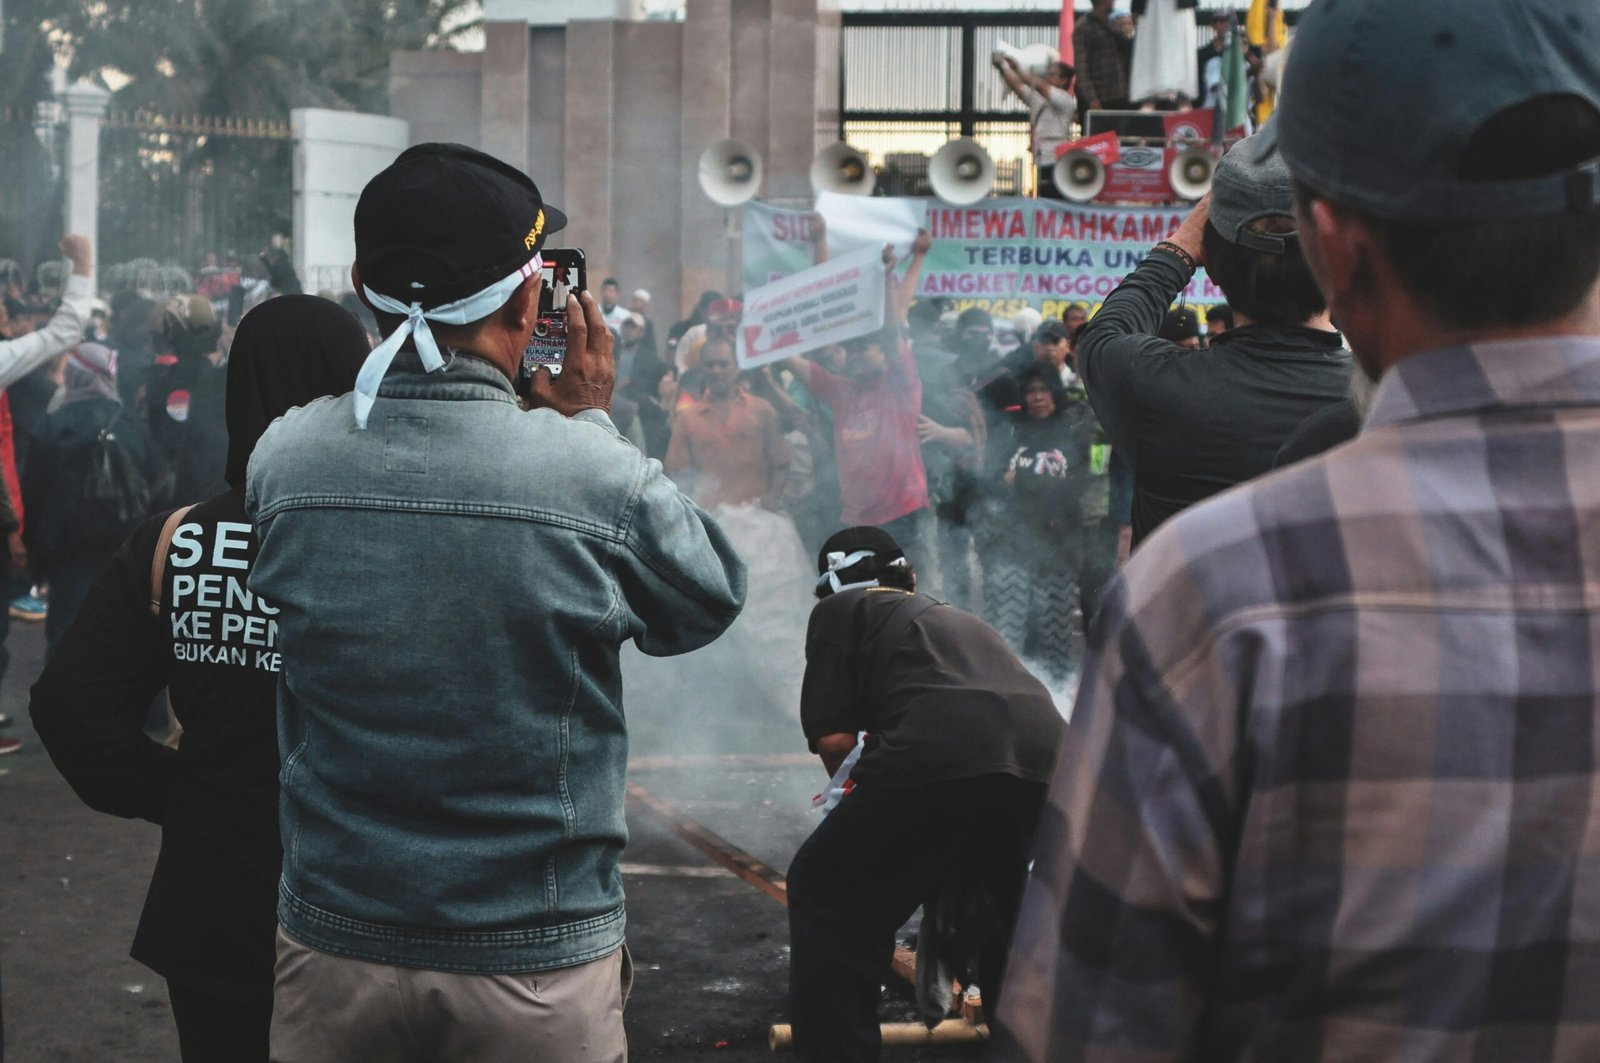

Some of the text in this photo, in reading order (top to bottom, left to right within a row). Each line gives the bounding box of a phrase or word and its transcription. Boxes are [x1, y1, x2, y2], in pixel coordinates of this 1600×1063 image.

[926, 208, 1027, 240] IMEWA
[963, 245, 1151, 268] TERBUKA UN
[923, 271, 1018, 294] ANGKET
[169, 521, 253, 570] SE
[171, 610, 212, 640] KE
[173, 642, 247, 666] BUKAN
